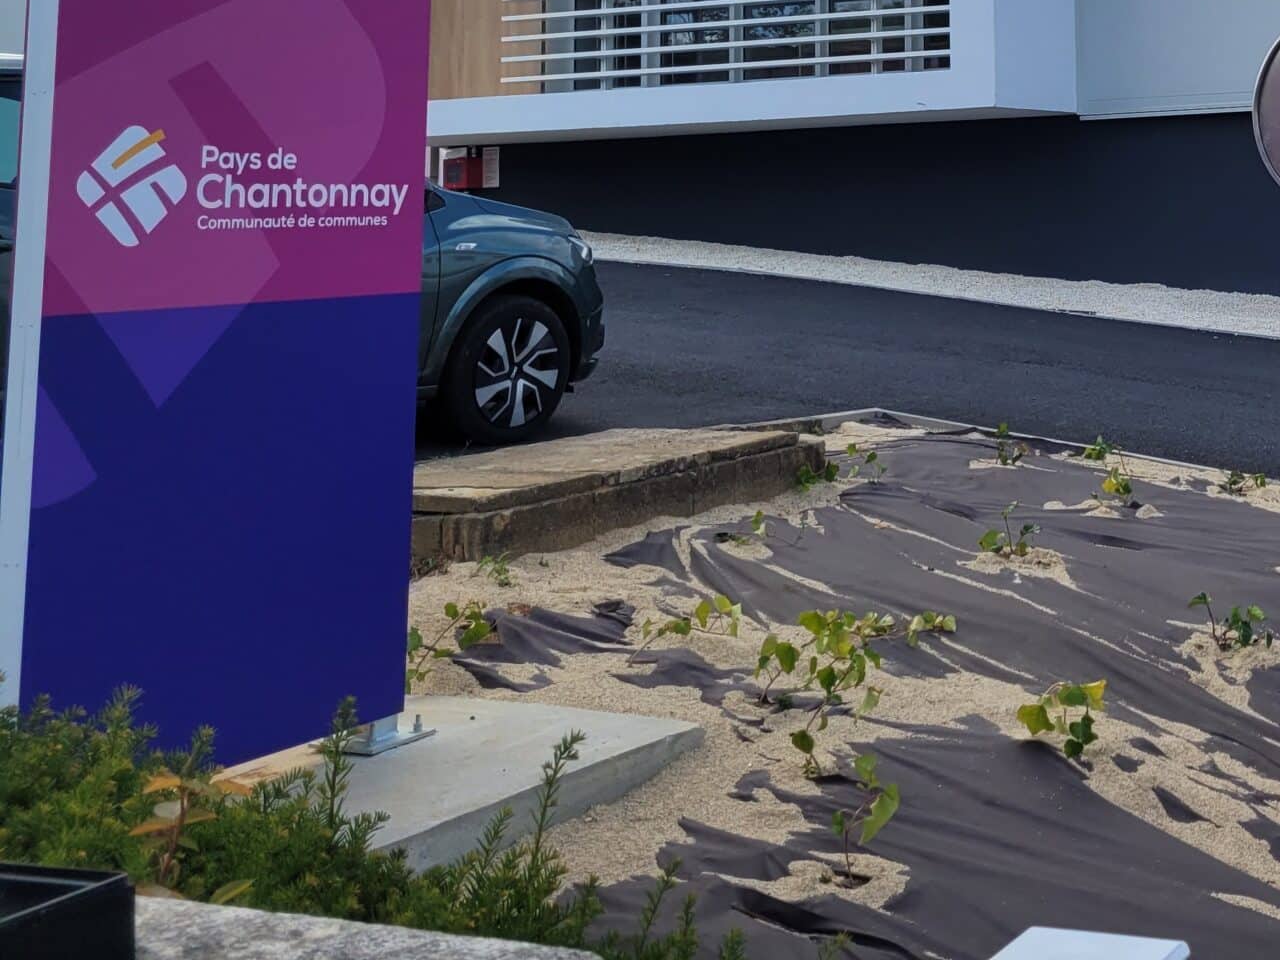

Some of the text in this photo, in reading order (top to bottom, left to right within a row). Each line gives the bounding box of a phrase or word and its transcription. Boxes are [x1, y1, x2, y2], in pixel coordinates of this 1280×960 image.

[201, 145, 297, 175] Pays de
[196, 173, 409, 215] Chantonnay
[197, 213, 388, 230] Communauté de communes
